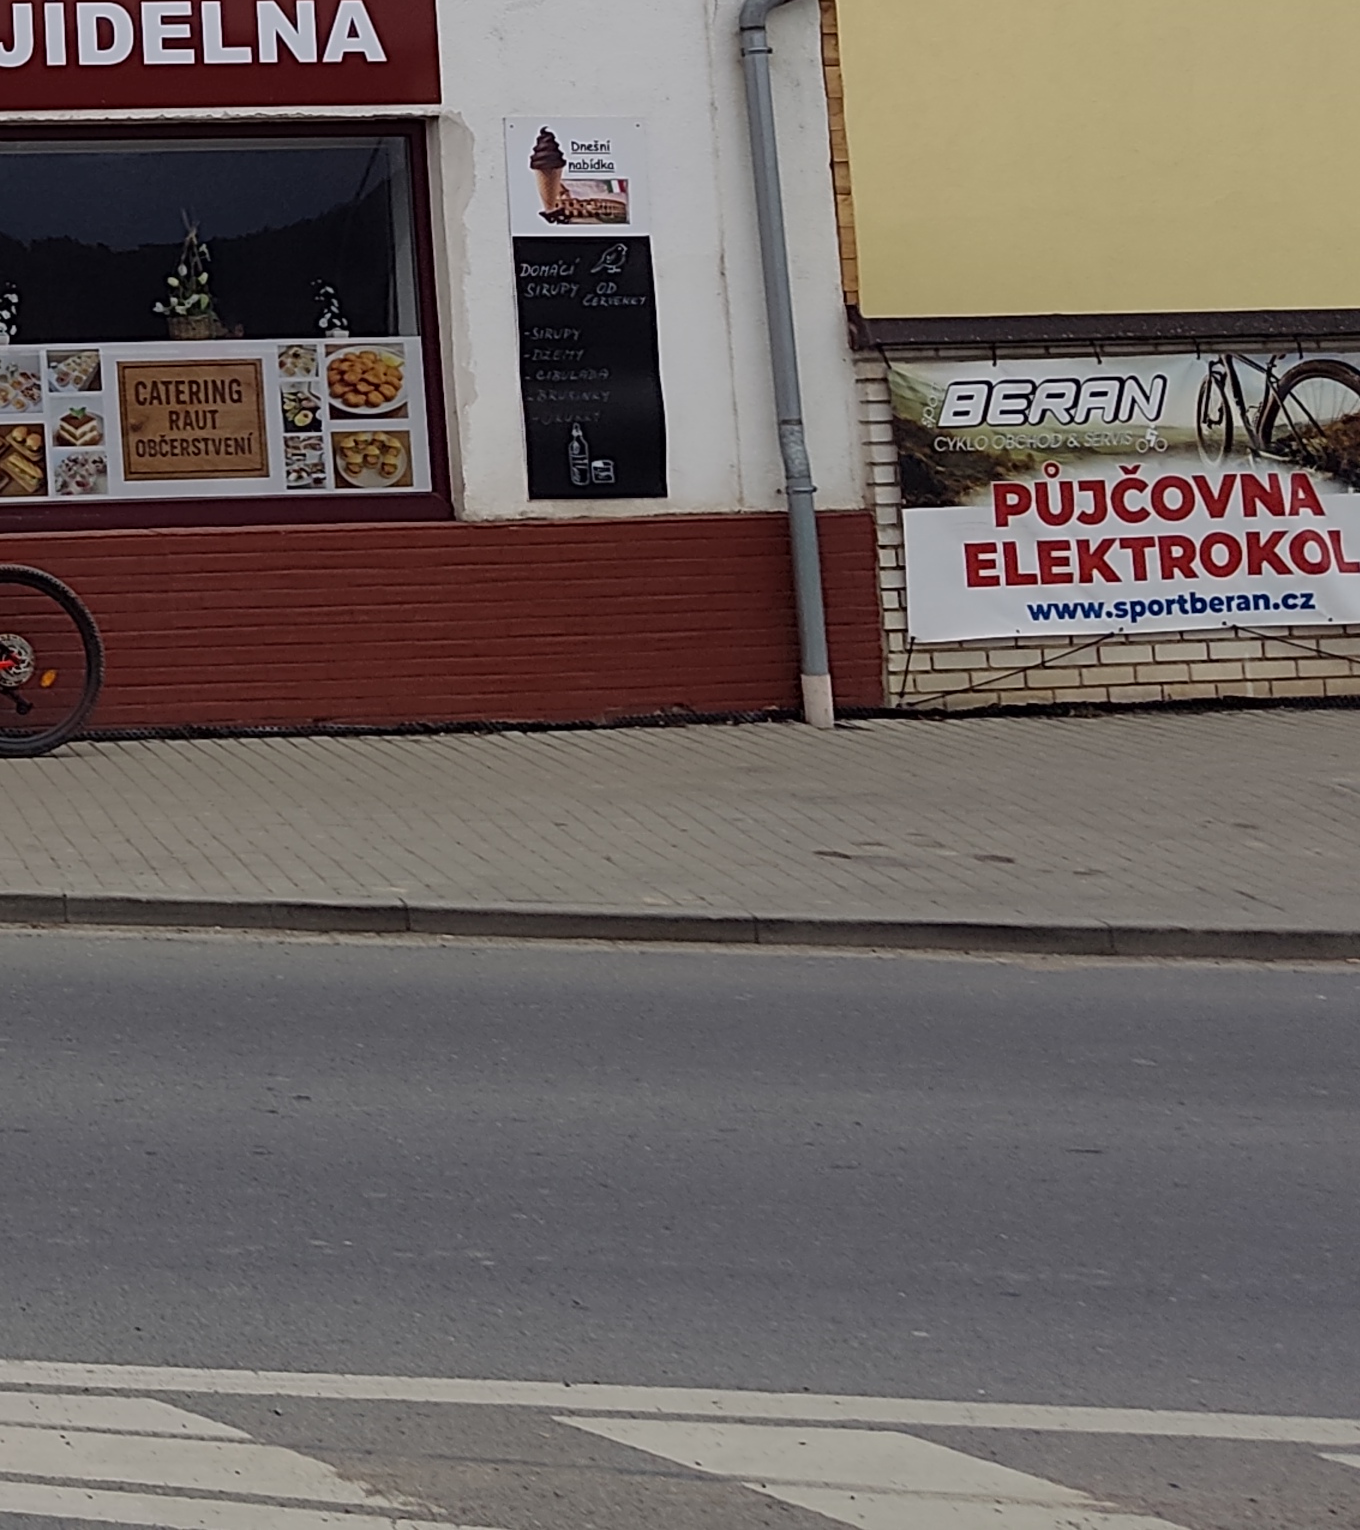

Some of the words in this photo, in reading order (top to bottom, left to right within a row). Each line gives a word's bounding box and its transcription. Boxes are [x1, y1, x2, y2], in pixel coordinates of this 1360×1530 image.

[571, 140, 610, 152] Dnešní
[569, 158, 615, 170] nabídka
[596, 282, 617, 294] OD
[135, 379, 242, 406] CATERING
[937, 374, 1168, 428] BERAN
[169, 410, 218, 430] RAUT
[135, 432, 253, 457] OBČERSTVENÍ
[934, 435, 988, 452] CYKLO
[992, 433, 1062, 450] OBCHOD
[1067, 433, 1080, 448] &
[1083, 431, 1133, 447] SERVIS
[993, 462, 1326, 527] PŮJČOVNA
[964, 529, 1360, 588] ELEKTROKOL
[1027, 591, 1316, 622] www.sportberan.cz
